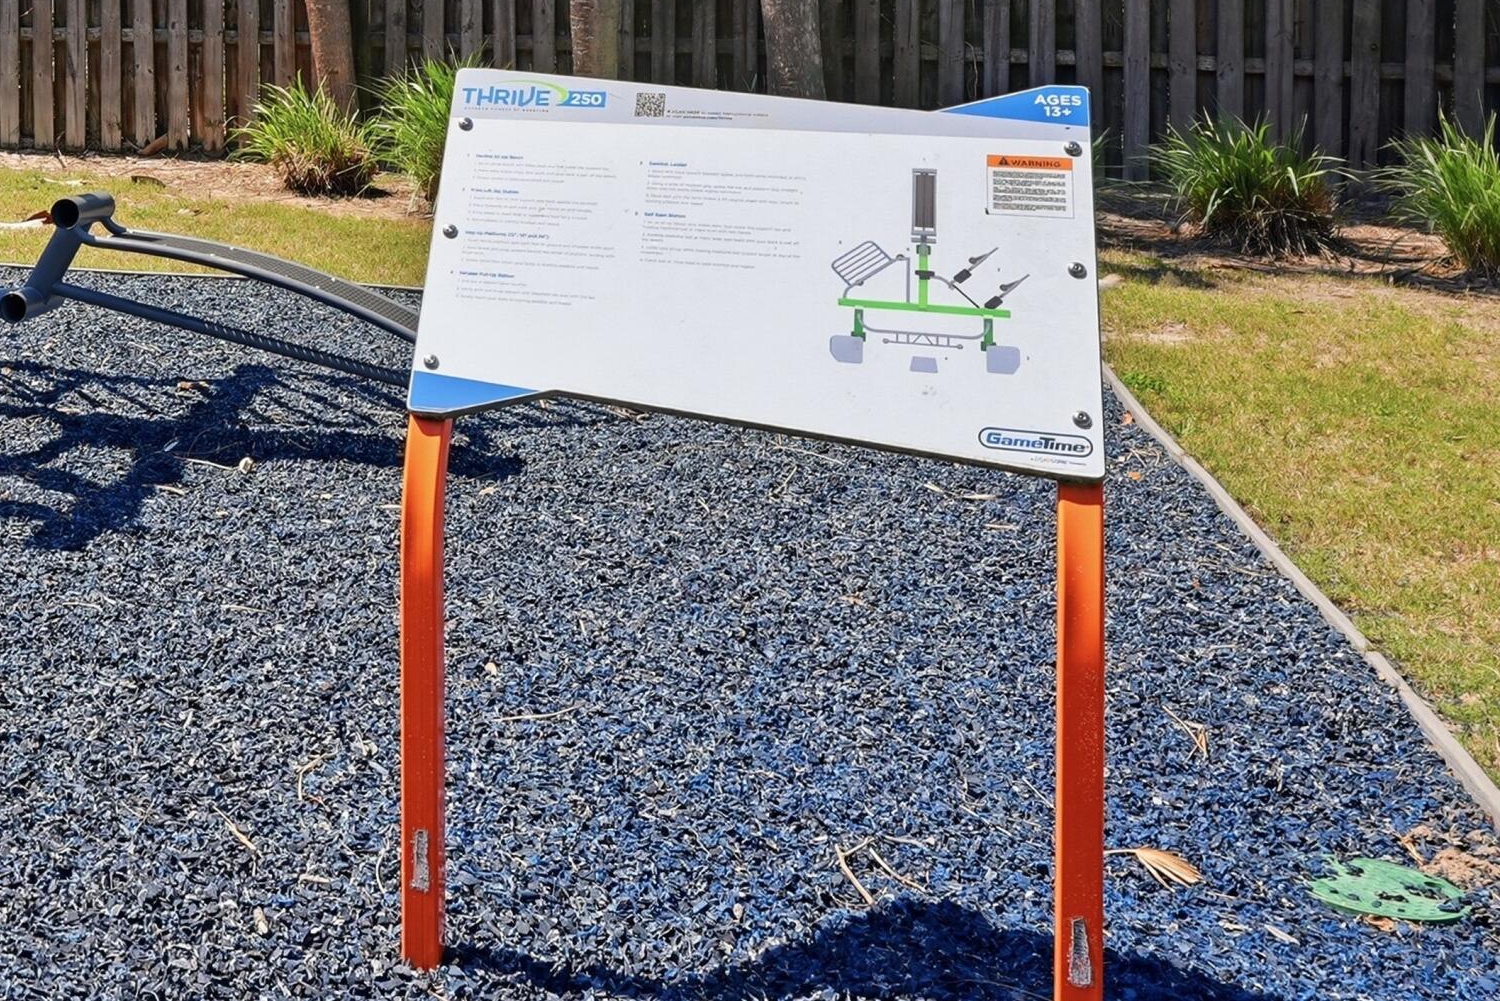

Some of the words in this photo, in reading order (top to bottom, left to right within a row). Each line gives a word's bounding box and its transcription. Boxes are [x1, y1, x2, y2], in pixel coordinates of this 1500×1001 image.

[462, 86, 551, 107] THRIVE
[570, 93, 602, 105] 250
[1034, 94, 1082, 106] AGES
[1044, 106, 1072, 117] 13+
[1011, 159, 1061, 168] WARNING
[986, 432, 1086, 453] GameTime
